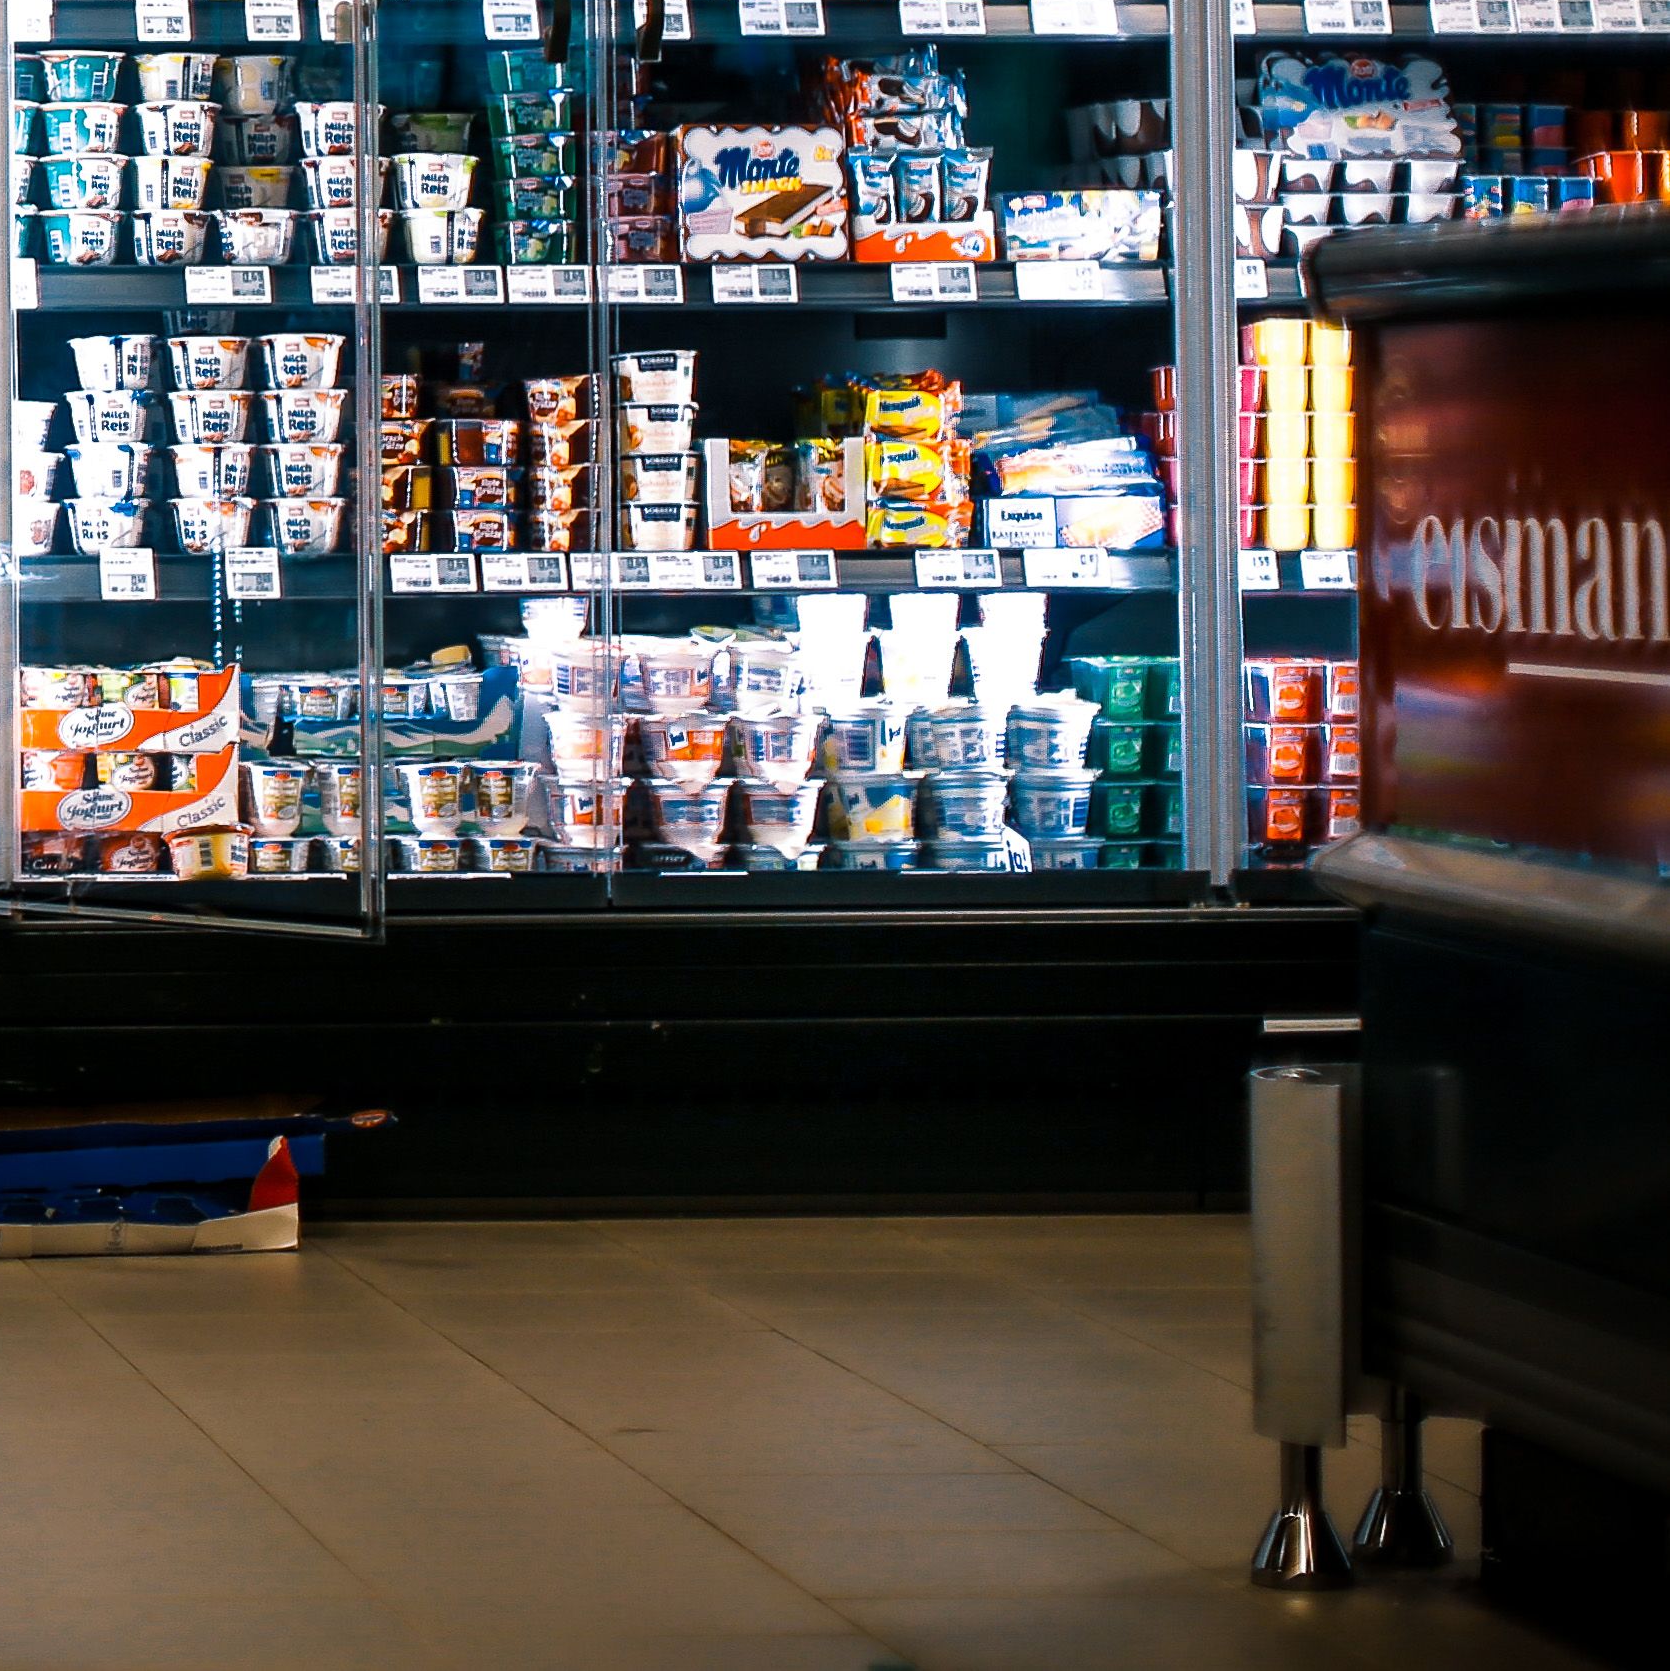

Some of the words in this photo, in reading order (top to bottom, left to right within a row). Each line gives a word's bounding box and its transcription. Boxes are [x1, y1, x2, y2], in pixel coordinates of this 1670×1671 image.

[1303, 63, 1411, 109] Monte
[172, 121, 201, 131] Milch
[325, 122, 354, 132] Milch
[172, 131, 201, 143] Reis
[325, 132, 354, 145] Reis
[713, 145, 800, 189] Monte
[420, 173, 449, 184] Milch
[172, 185, 199, 198] Reis
[420, 184, 449, 195] Reis
[741, 177, 802, 194] SNACK
[156, 229, 184, 239] Milch
[81, 237, 104, 246] Reis
[156, 239, 184, 251] Reis
[330, 238, 356, 250] Reis
[194, 356, 221, 365] Milch
[194, 365, 221, 378] Reis
[880, 396, 921, 411] Nesquik
[101, 410, 130, 419] Milch
[202, 410, 230, 419] Milch
[287, 409, 317, 419] Milch
[101, 419, 130, 432] Reis
[202, 419, 230, 432] Reis
[287, 419, 317, 432] Reis
[284, 463, 312, 473] Milch
[284, 473, 312, 485] Reis
[882, 516, 926, 529] Nesquik
[178, 715, 228, 747] Classic
[66, 801, 123, 818] Joghurt
[177, 797, 226, 829] Classic
